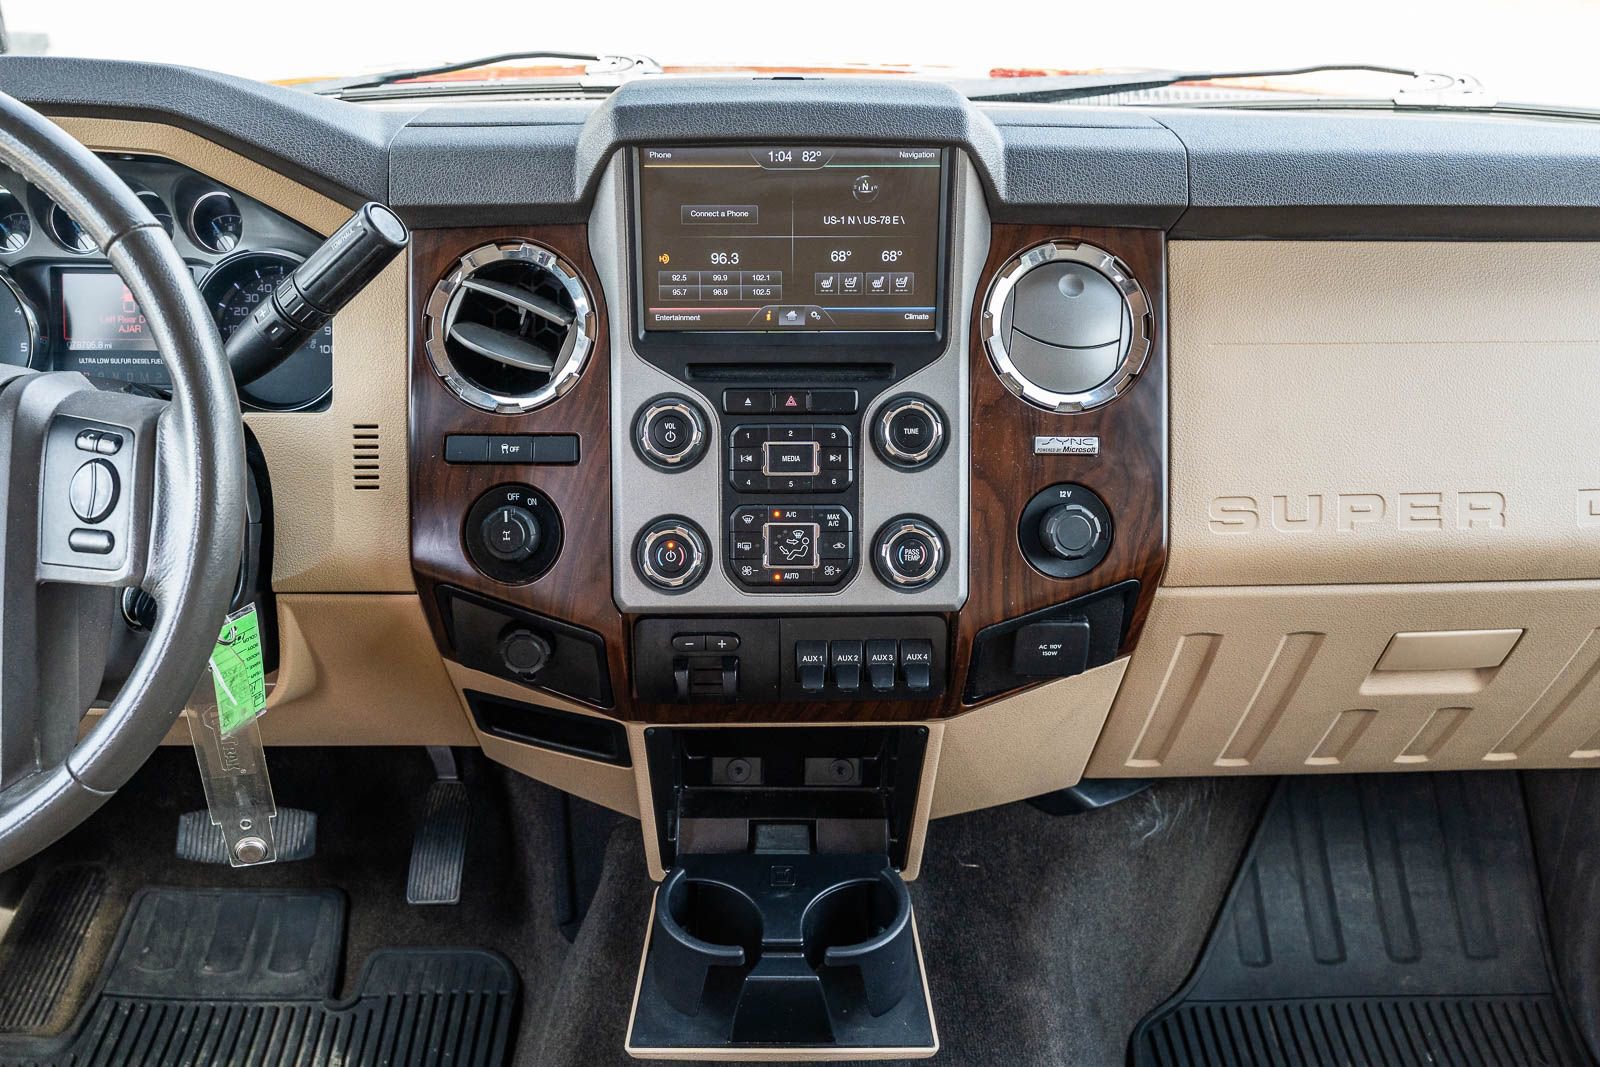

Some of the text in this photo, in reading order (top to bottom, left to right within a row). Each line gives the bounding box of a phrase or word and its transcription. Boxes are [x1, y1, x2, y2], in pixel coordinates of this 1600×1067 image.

[768, 151, 792, 162] 1:04
[823, 216, 845, 225] US-1
[847, 216, 855, 225] N
[863, 216, 891, 225] US-78
[892, 216, 899, 225] E
[711, 253, 739, 264] 96.3
[257, 284, 272, 292] 40
[245, 293, 259, 303] 30
[14, 305, 22, 315] 4
[233, 307, 248, 316] 20
[118, 325, 142, 333] AJAR
[20, 342, 28, 352] 5
[1042, 437, 1094, 446] SYNC
[1062, 445, 1096, 453] Microsoft
[507, 493, 520, 501] OFF
[1059, 490, 1072, 498] 12V
[527, 497, 537, 506] ON
[1208, 490, 1506, 535] SUPER
